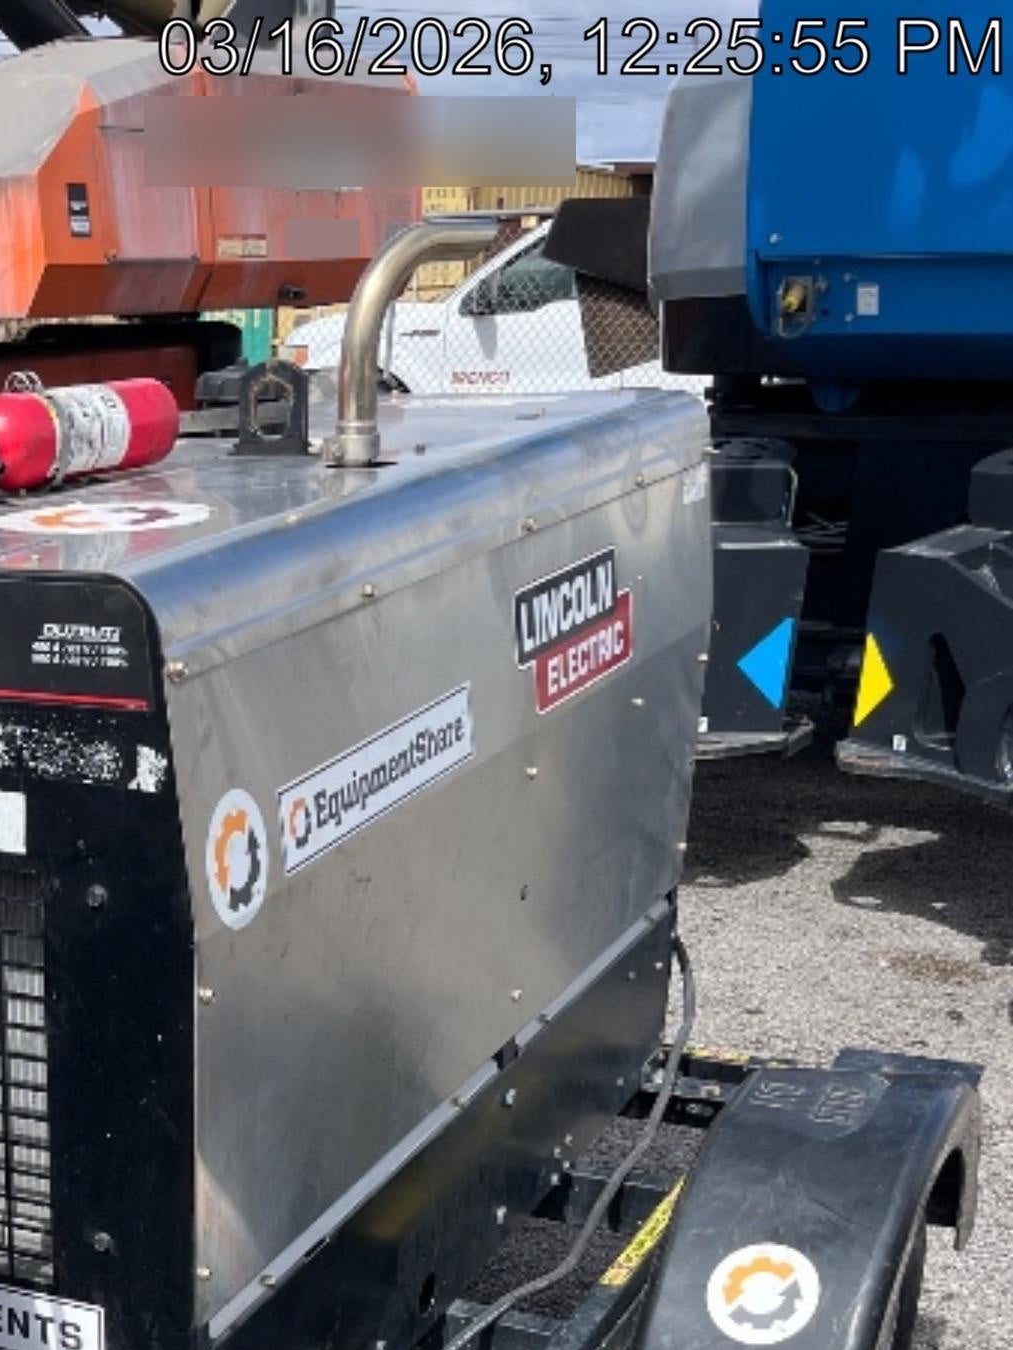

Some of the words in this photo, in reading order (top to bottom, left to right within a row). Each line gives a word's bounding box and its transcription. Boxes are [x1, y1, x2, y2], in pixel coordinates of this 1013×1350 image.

[520, 559, 613, 652] LINCOLN
[547, 620, 624, 697] ELECTRIC
[313, 716, 465, 828] EquipmentShare
